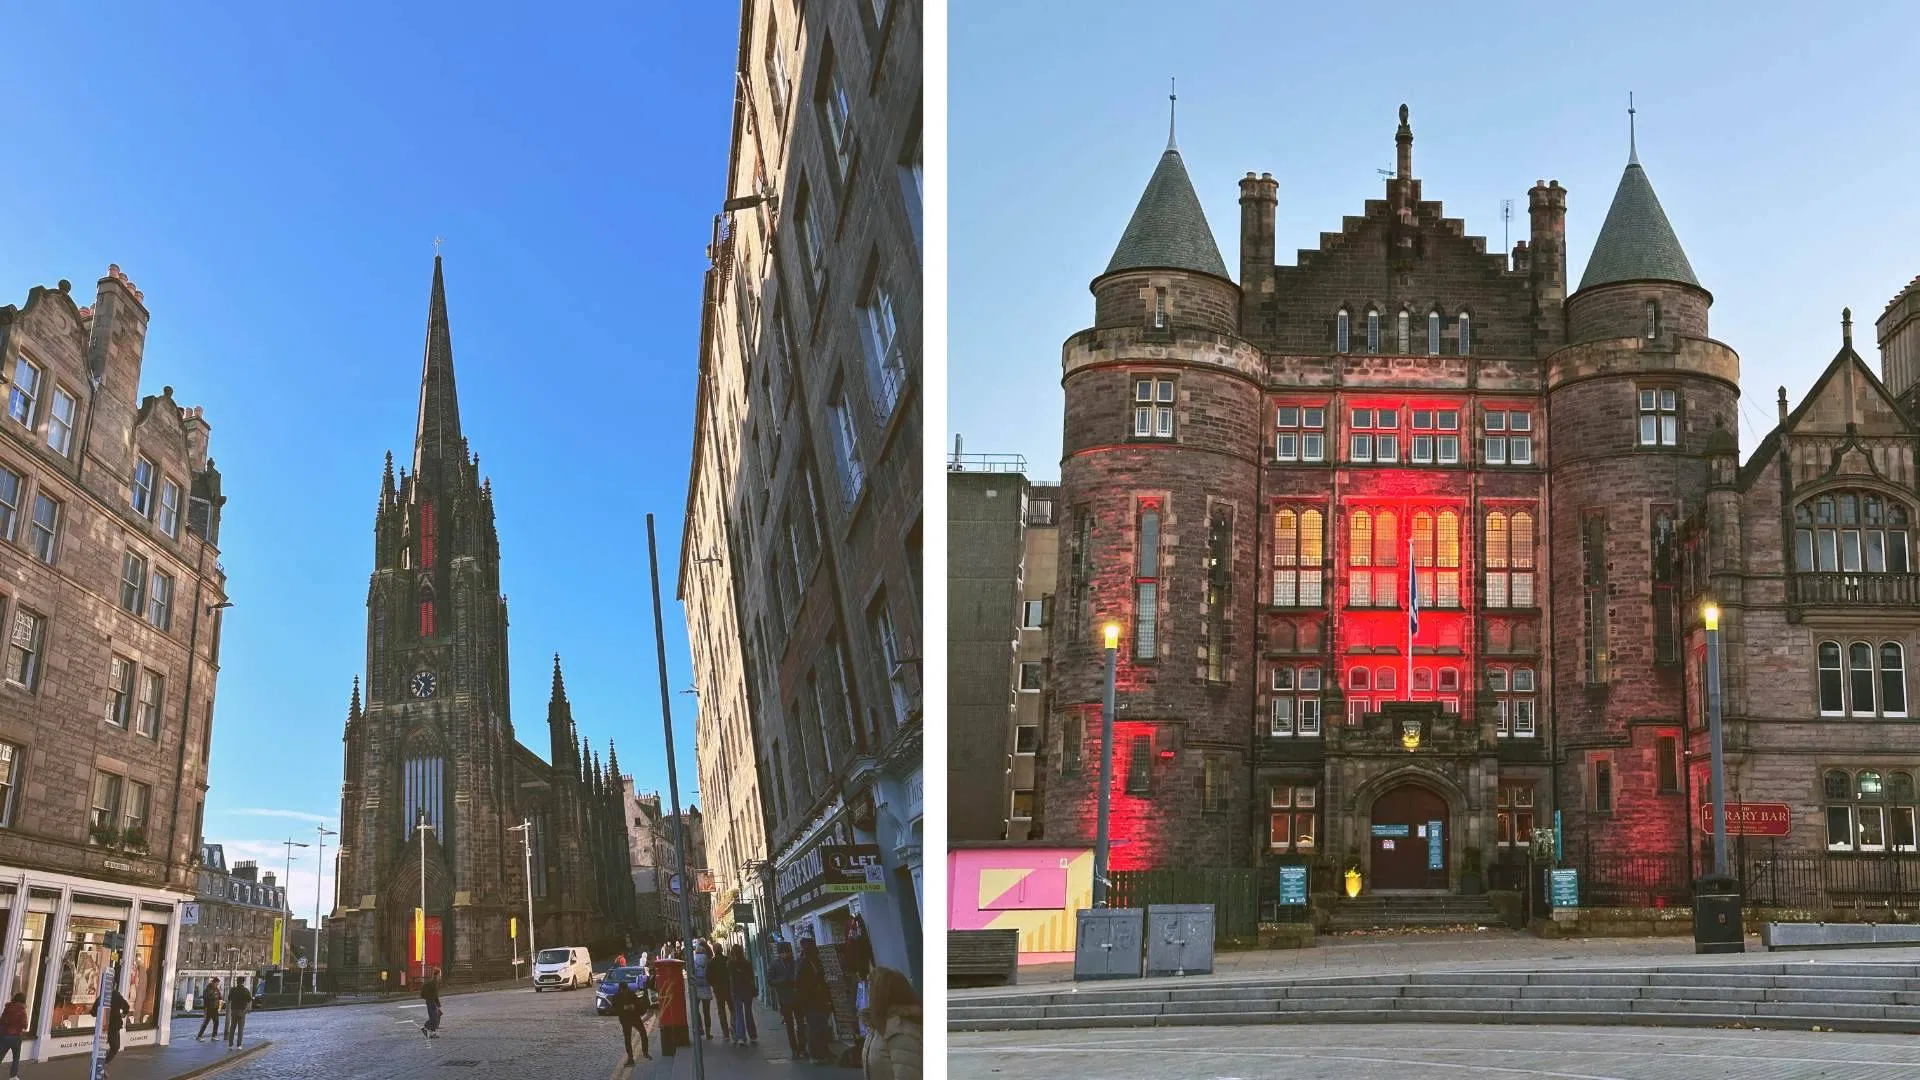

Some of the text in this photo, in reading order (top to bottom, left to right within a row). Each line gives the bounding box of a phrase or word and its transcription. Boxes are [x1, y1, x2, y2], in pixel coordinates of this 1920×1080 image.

[1704, 810, 1786, 821] LRARY BAR
[849, 855, 877, 866] LET
[185, 906, 193, 918] K
